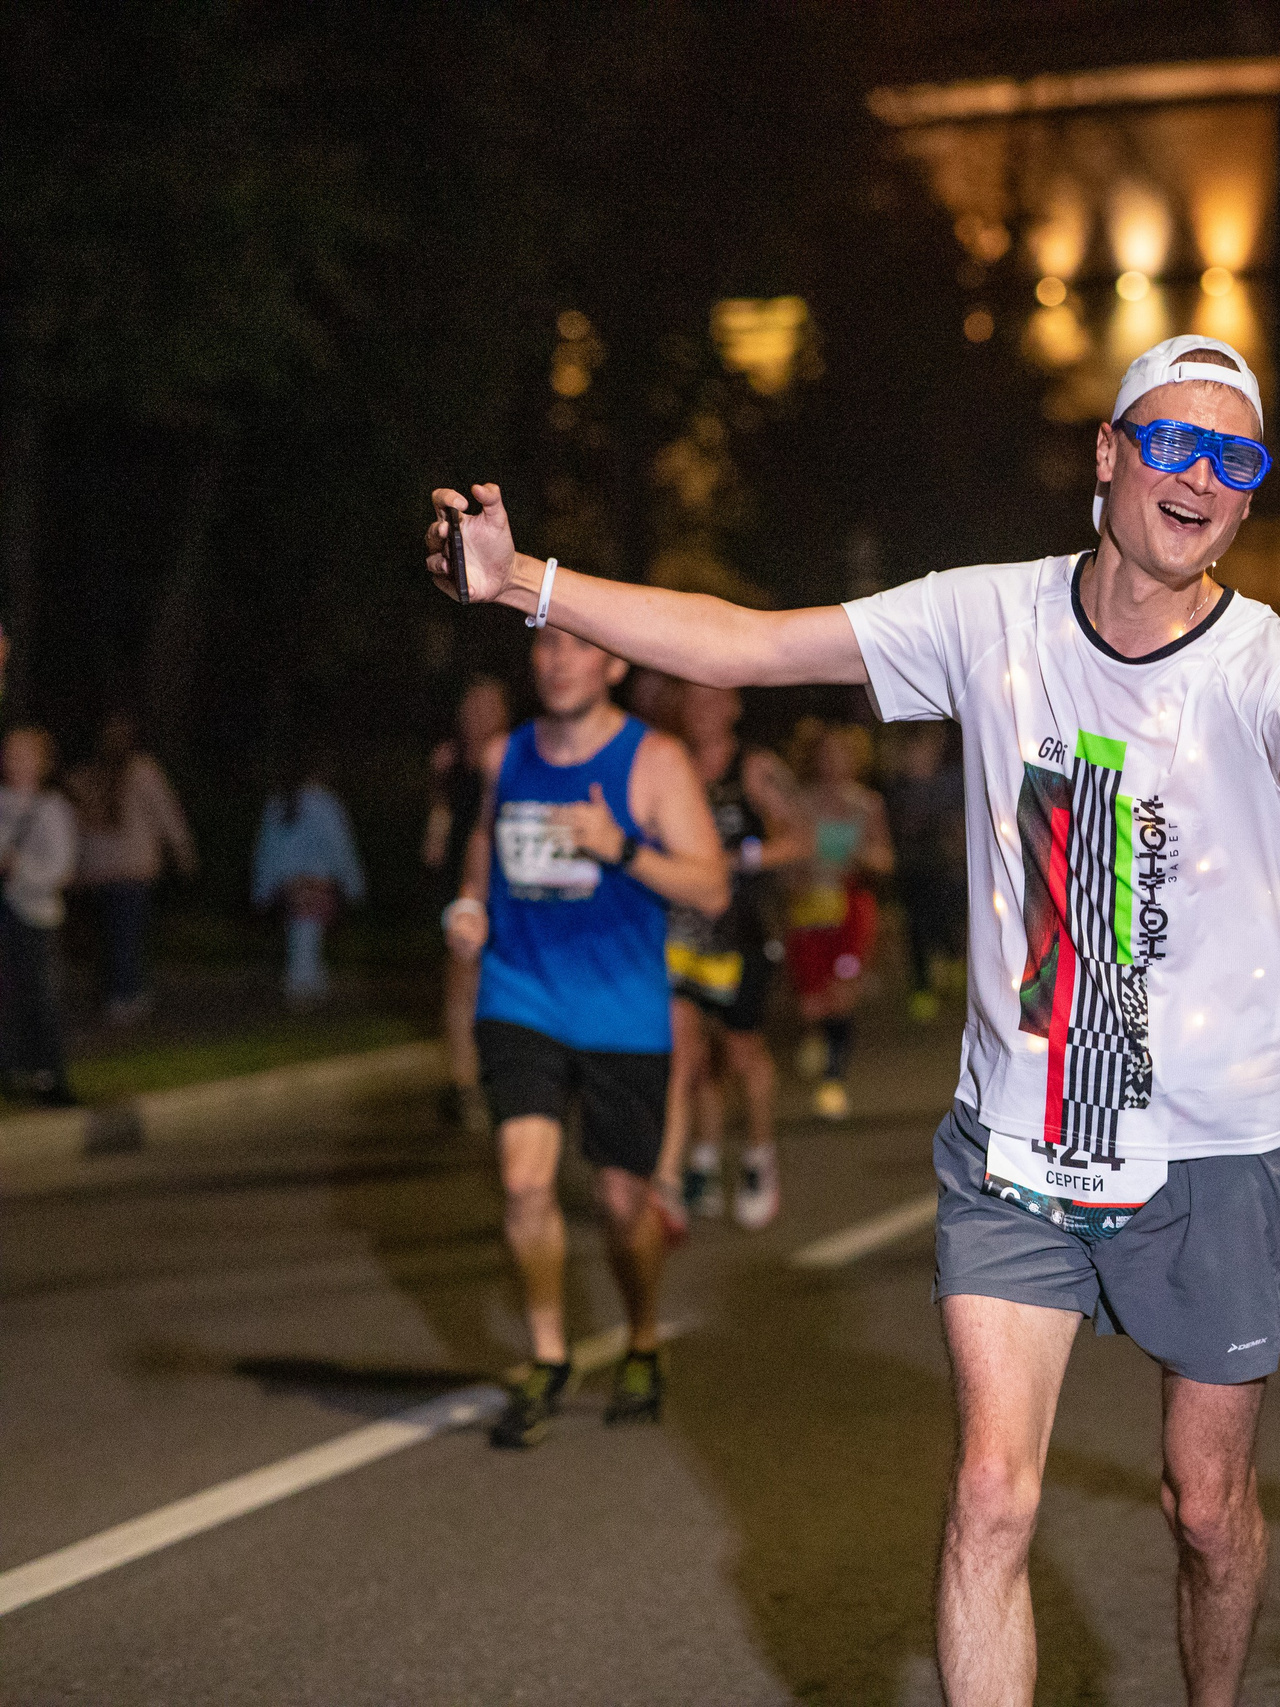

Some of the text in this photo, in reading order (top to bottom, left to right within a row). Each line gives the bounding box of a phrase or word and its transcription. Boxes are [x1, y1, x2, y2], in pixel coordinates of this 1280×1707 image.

[1133, 795, 1168, 966] НОЧНОЙ
[1168, 823, 1179, 883] ЗАБЕГ
[1046, 1170, 1104, 1192] СЕРГЕЙ
